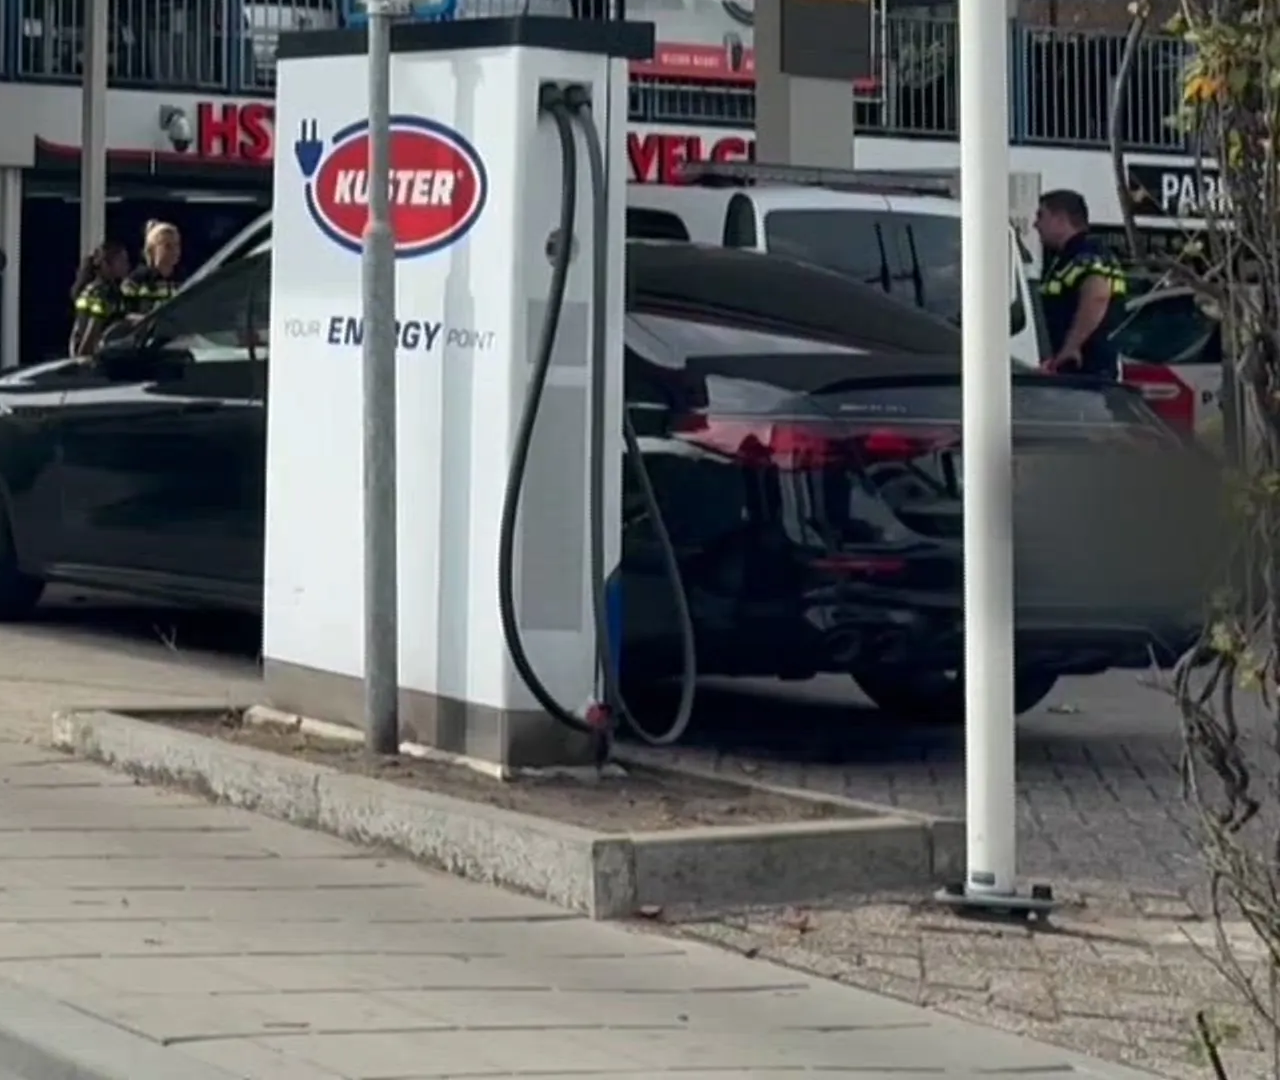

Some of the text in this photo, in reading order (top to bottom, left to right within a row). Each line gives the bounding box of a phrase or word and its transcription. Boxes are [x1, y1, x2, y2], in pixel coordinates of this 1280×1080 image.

[284, 316, 495, 351] YOUR ENGY POINT
